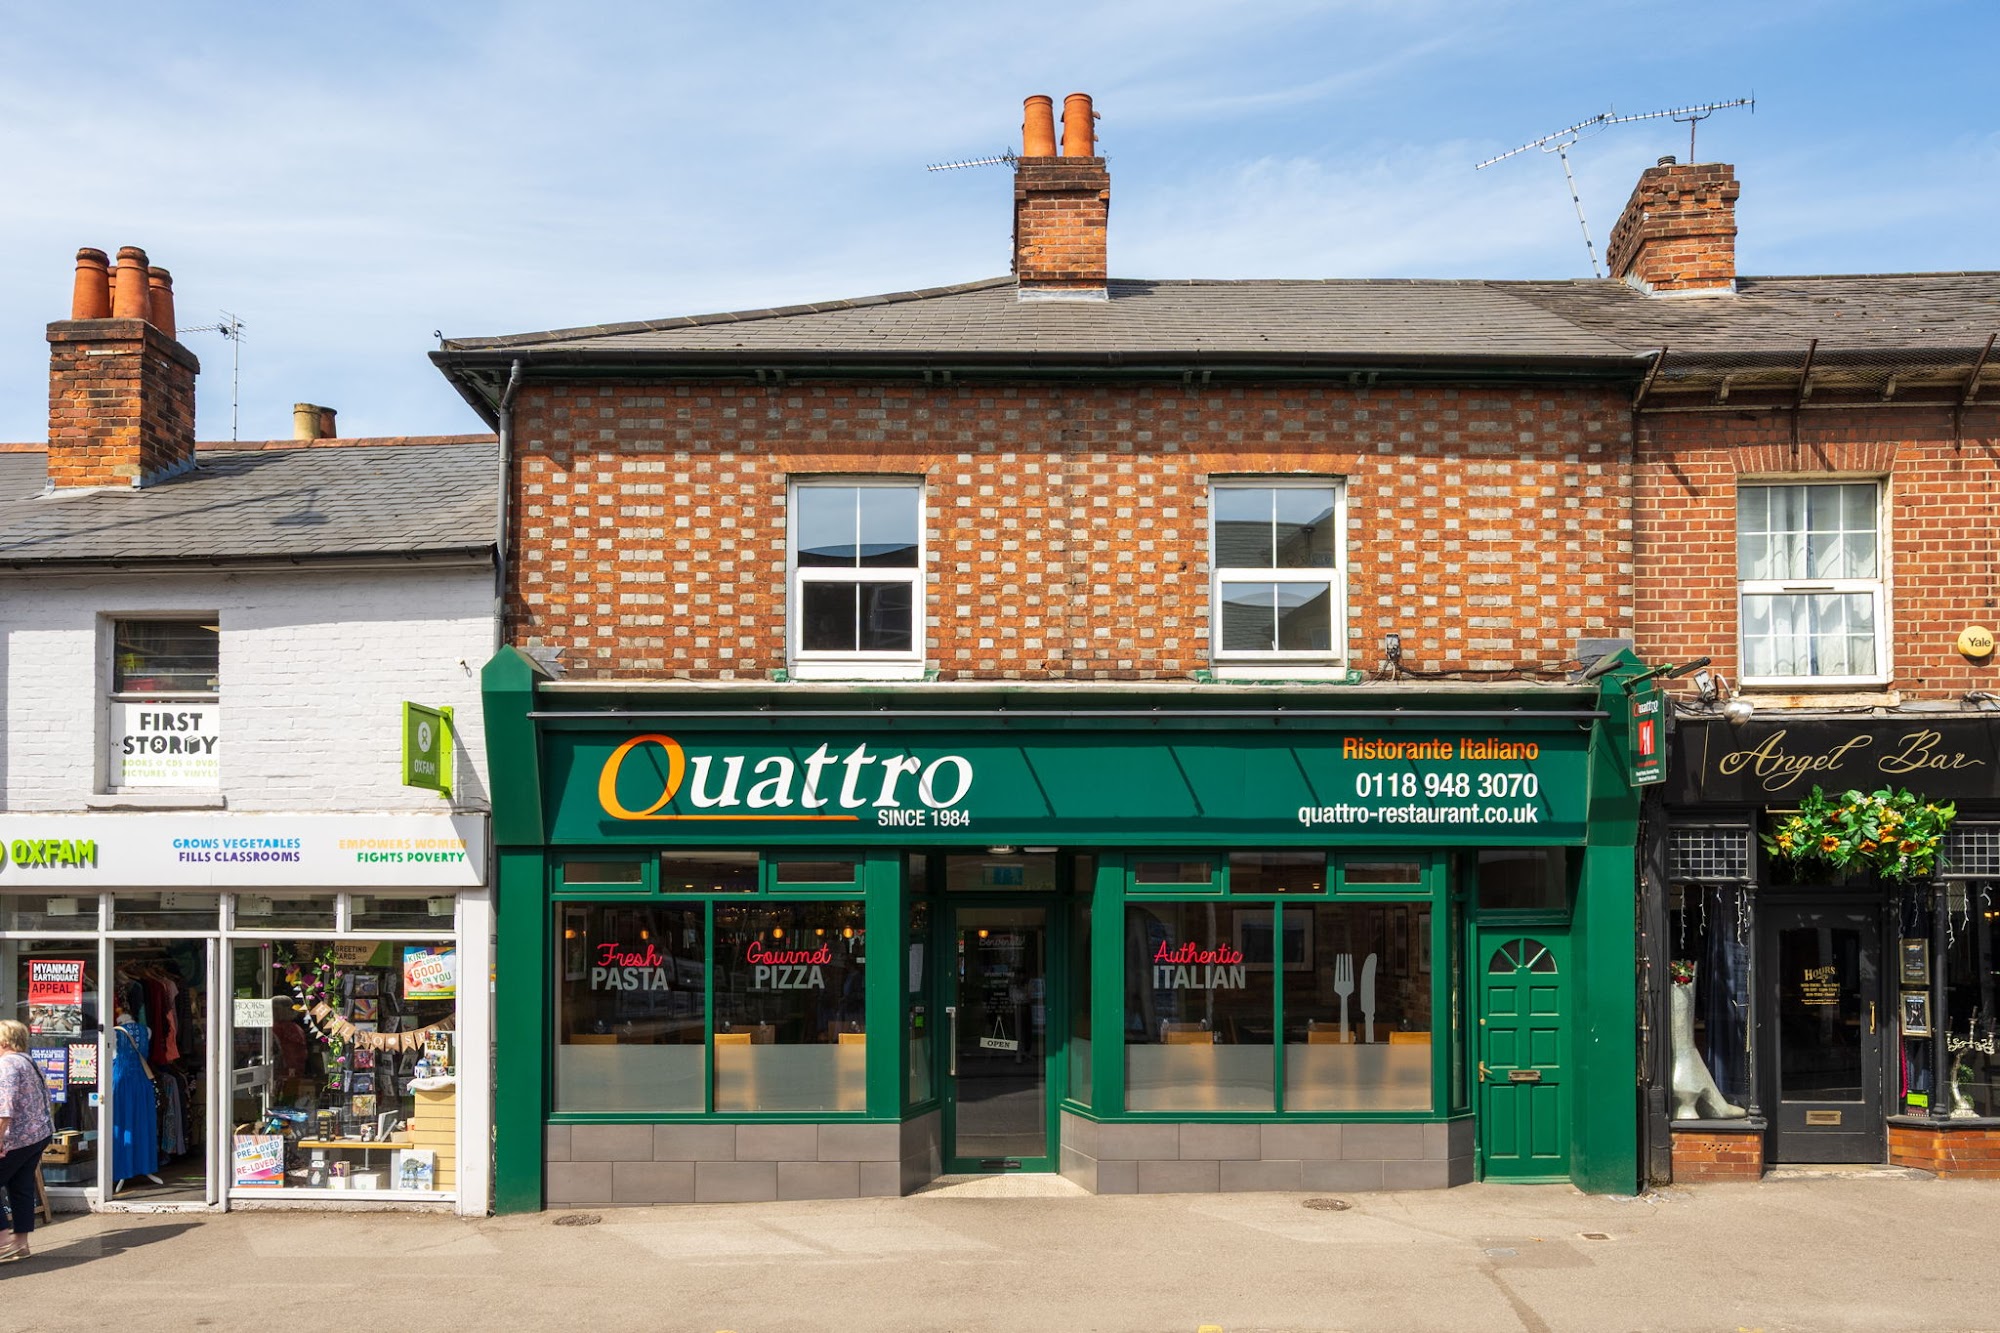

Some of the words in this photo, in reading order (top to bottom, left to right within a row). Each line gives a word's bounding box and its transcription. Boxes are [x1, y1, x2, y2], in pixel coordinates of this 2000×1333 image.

[1968, 637, 1991, 647] Yale
[1633, 700, 1659, 717] Quattro
[140, 712, 203, 731] FIRST
[1343, 737, 1453, 760] Ristorante
[1460, 737, 1539, 760] Italiano
[122, 759, 153, 767] BOOKS
[195, 759, 218, 768] DVDS
[414, 759, 435, 775] OXFAM
[1719, 729, 1873, 791] Angel
[1877, 728, 1985, 774] Bar
[122, 770, 167, 778] PICTURES
[184, 770, 218, 778] VINYLS
[598, 733, 973, 821] Quattro
[1356, 772, 1417, 797] 0118
[1424, 772, 1470, 797] 948
[1477, 772, 1539, 797] 3070
[878, 809, 926, 827] SINCE
[930, 809, 970, 827] 1984
[1298, 803, 1539, 827] quattro-restaurant.co.uk
[11, 839, 95, 864] OXFAM
[173, 838, 220, 849] GROWS
[223, 838, 301, 849] VEGETABLES
[339, 839, 412, 849] EMPOWERS
[415, 839, 467, 849] WOMEN
[179, 851, 212, 862] FILLS
[214, 851, 300, 862] CLASSROOMS
[357, 852, 403, 862] FIGHTS
[407, 852, 465, 862] POVERTY
[335, 945, 367, 953] GREETING
[407, 951, 427, 963] KIND
[597, 943, 663, 967] Fresh
[747, 941, 832, 965] Gourmet
[1154, 940, 1243, 965] Authentic
[33, 963, 79, 974] MYANMAR
[413, 963, 443, 979] GOOD
[1804, 966, 1836, 981] HOURS
[33, 973, 79, 982] EARTHQUAKE
[432, 971, 451, 983] YOU
[592, 967, 669, 991] PASTA
[755, 965, 825, 989] PIZZA
[1153, 965, 1246, 989] ITALIAN
[32, 983, 72, 994] APPEAL
[234, 1001, 264, 1010] BOOKS
[242, 1010, 268, 1018] MUSIC
[987, 1040, 1010, 1048] OPEN
[236, 1141, 279, 1159] PRE-LOVED
[236, 1158, 275, 1176] RE-LOVED
